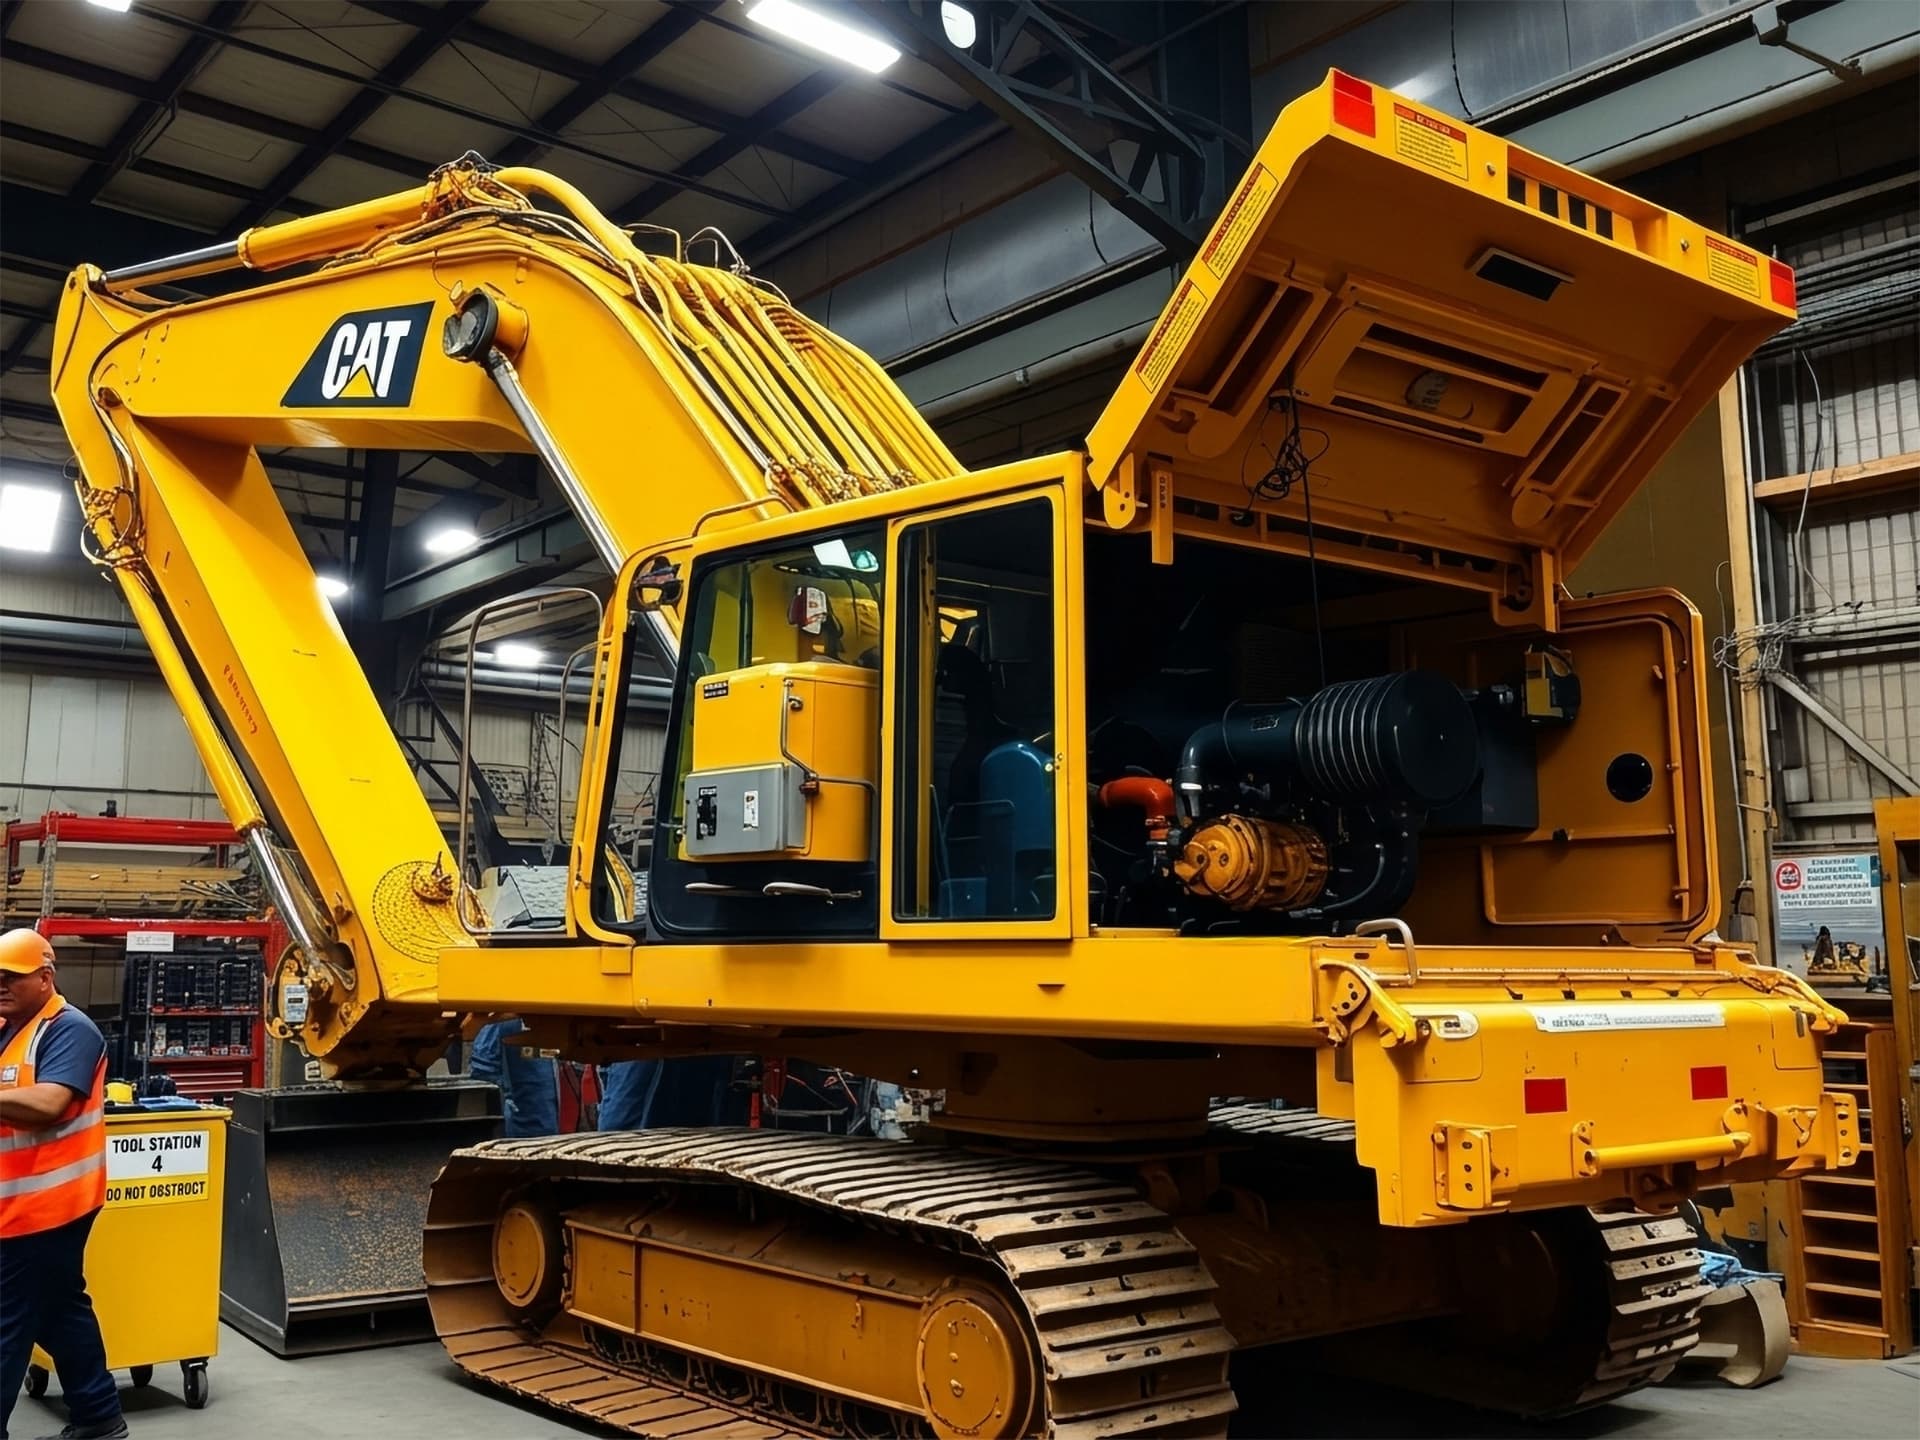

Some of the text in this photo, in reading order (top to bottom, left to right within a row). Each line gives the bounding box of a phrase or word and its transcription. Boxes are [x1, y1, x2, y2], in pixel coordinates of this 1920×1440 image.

[321, 320, 412, 400] CAT
[112, 1135, 201, 1153] TOOL STATION
[151, 1154, 163, 1172] 4
[106, 1181, 206, 1201] DO NOT OBSTRUCT
